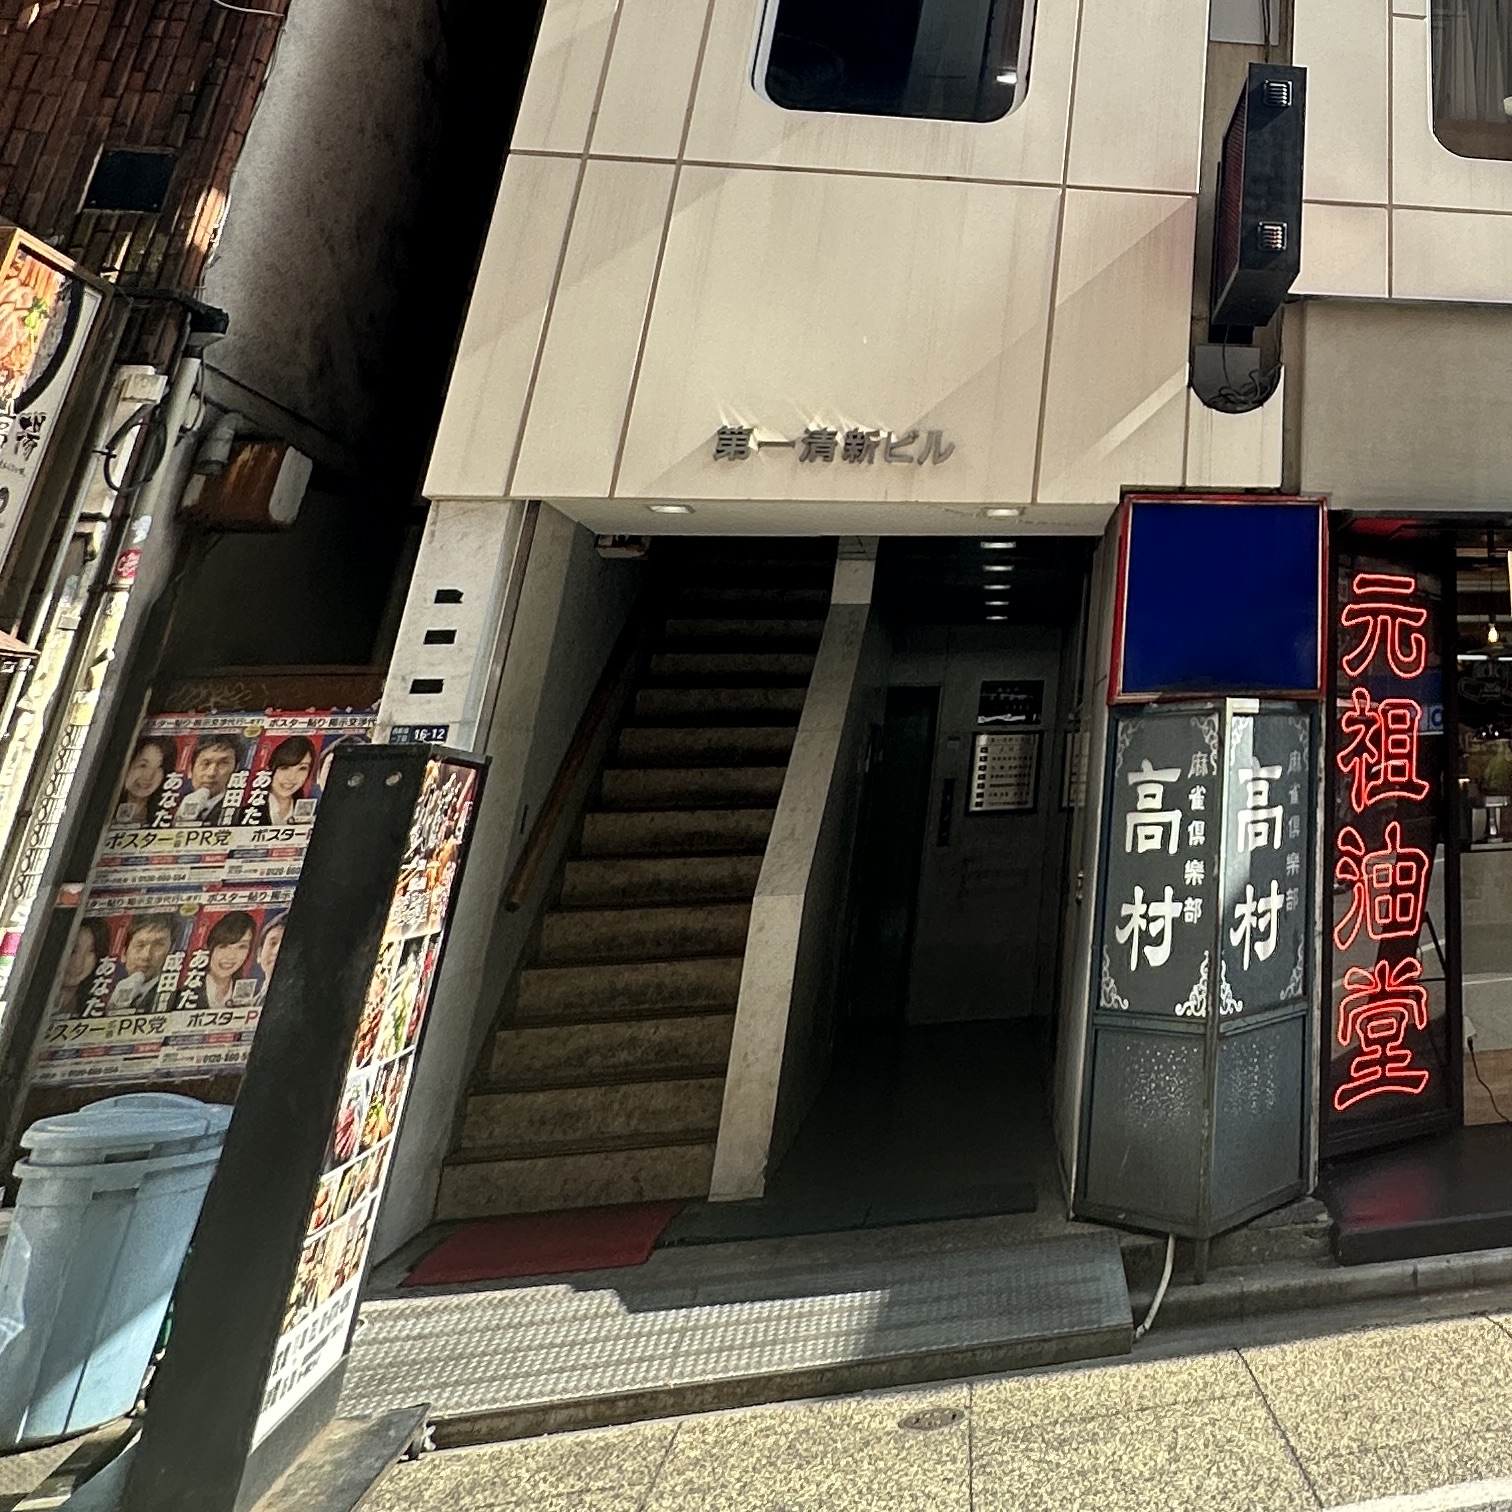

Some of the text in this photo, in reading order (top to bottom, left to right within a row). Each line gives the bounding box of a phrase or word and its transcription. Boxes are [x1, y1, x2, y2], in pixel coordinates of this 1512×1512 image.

[713, 424, 956, 466] 第一清新ビル
[413, 728, 446, 740] 16-12
[151, 771, 186, 829] あなた
[240, 769, 273, 826] あなた
[1115, 758, 1183, 971] 高村
[1230, 756, 1285, 972] 高村
[1333, 573, 1430, 1112] 元祖油堂
[81, 955, 118, 1018] あなた
[176, 949, 210, 1010] あなた
